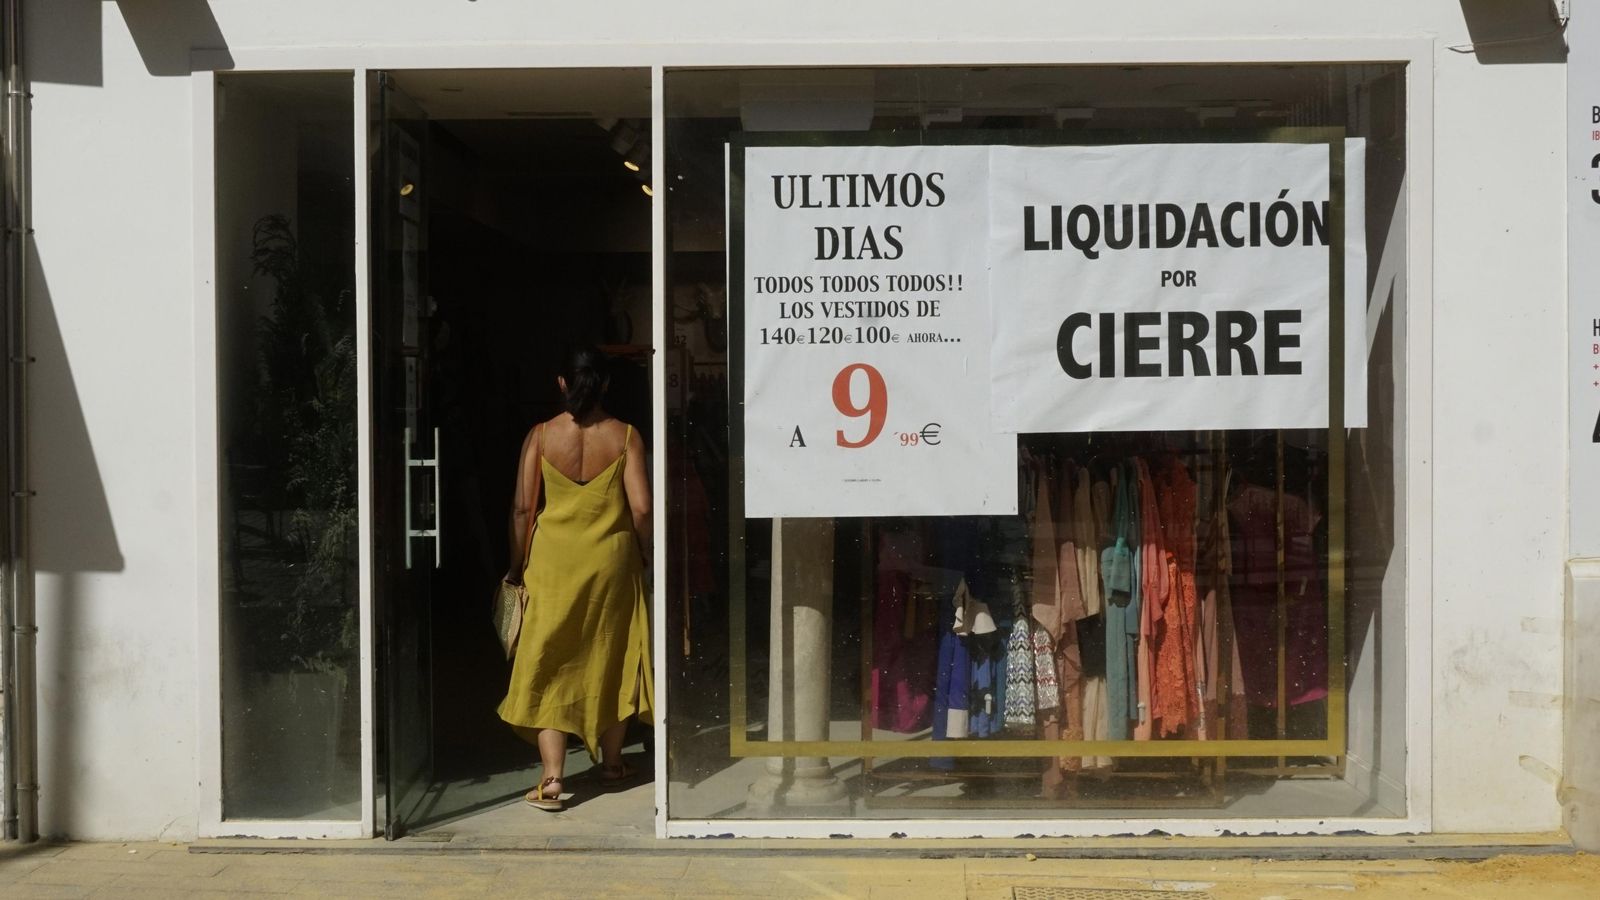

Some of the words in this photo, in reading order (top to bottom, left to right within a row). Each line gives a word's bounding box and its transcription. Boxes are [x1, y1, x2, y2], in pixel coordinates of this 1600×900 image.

[771, 171, 946, 210] ULTIMOS
[1023, 188, 1330, 261] LIQUIDACIÓN
[813, 224, 905, 261] DIAS
[753, 275, 814, 294] TODOS
[819, 274, 880, 293] TODOS
[885, 272, 964, 293] TODOS!!
[1160, 269, 1197, 288] POR
[779, 301, 815, 320] LOS
[820, 300, 910, 319] VESTIDOS
[916, 299, 941, 319] DE
[906, 332, 962, 344] AHORA...
[1055, 308, 1303, 380] CIERRE
[788, 424, 807, 448] A
